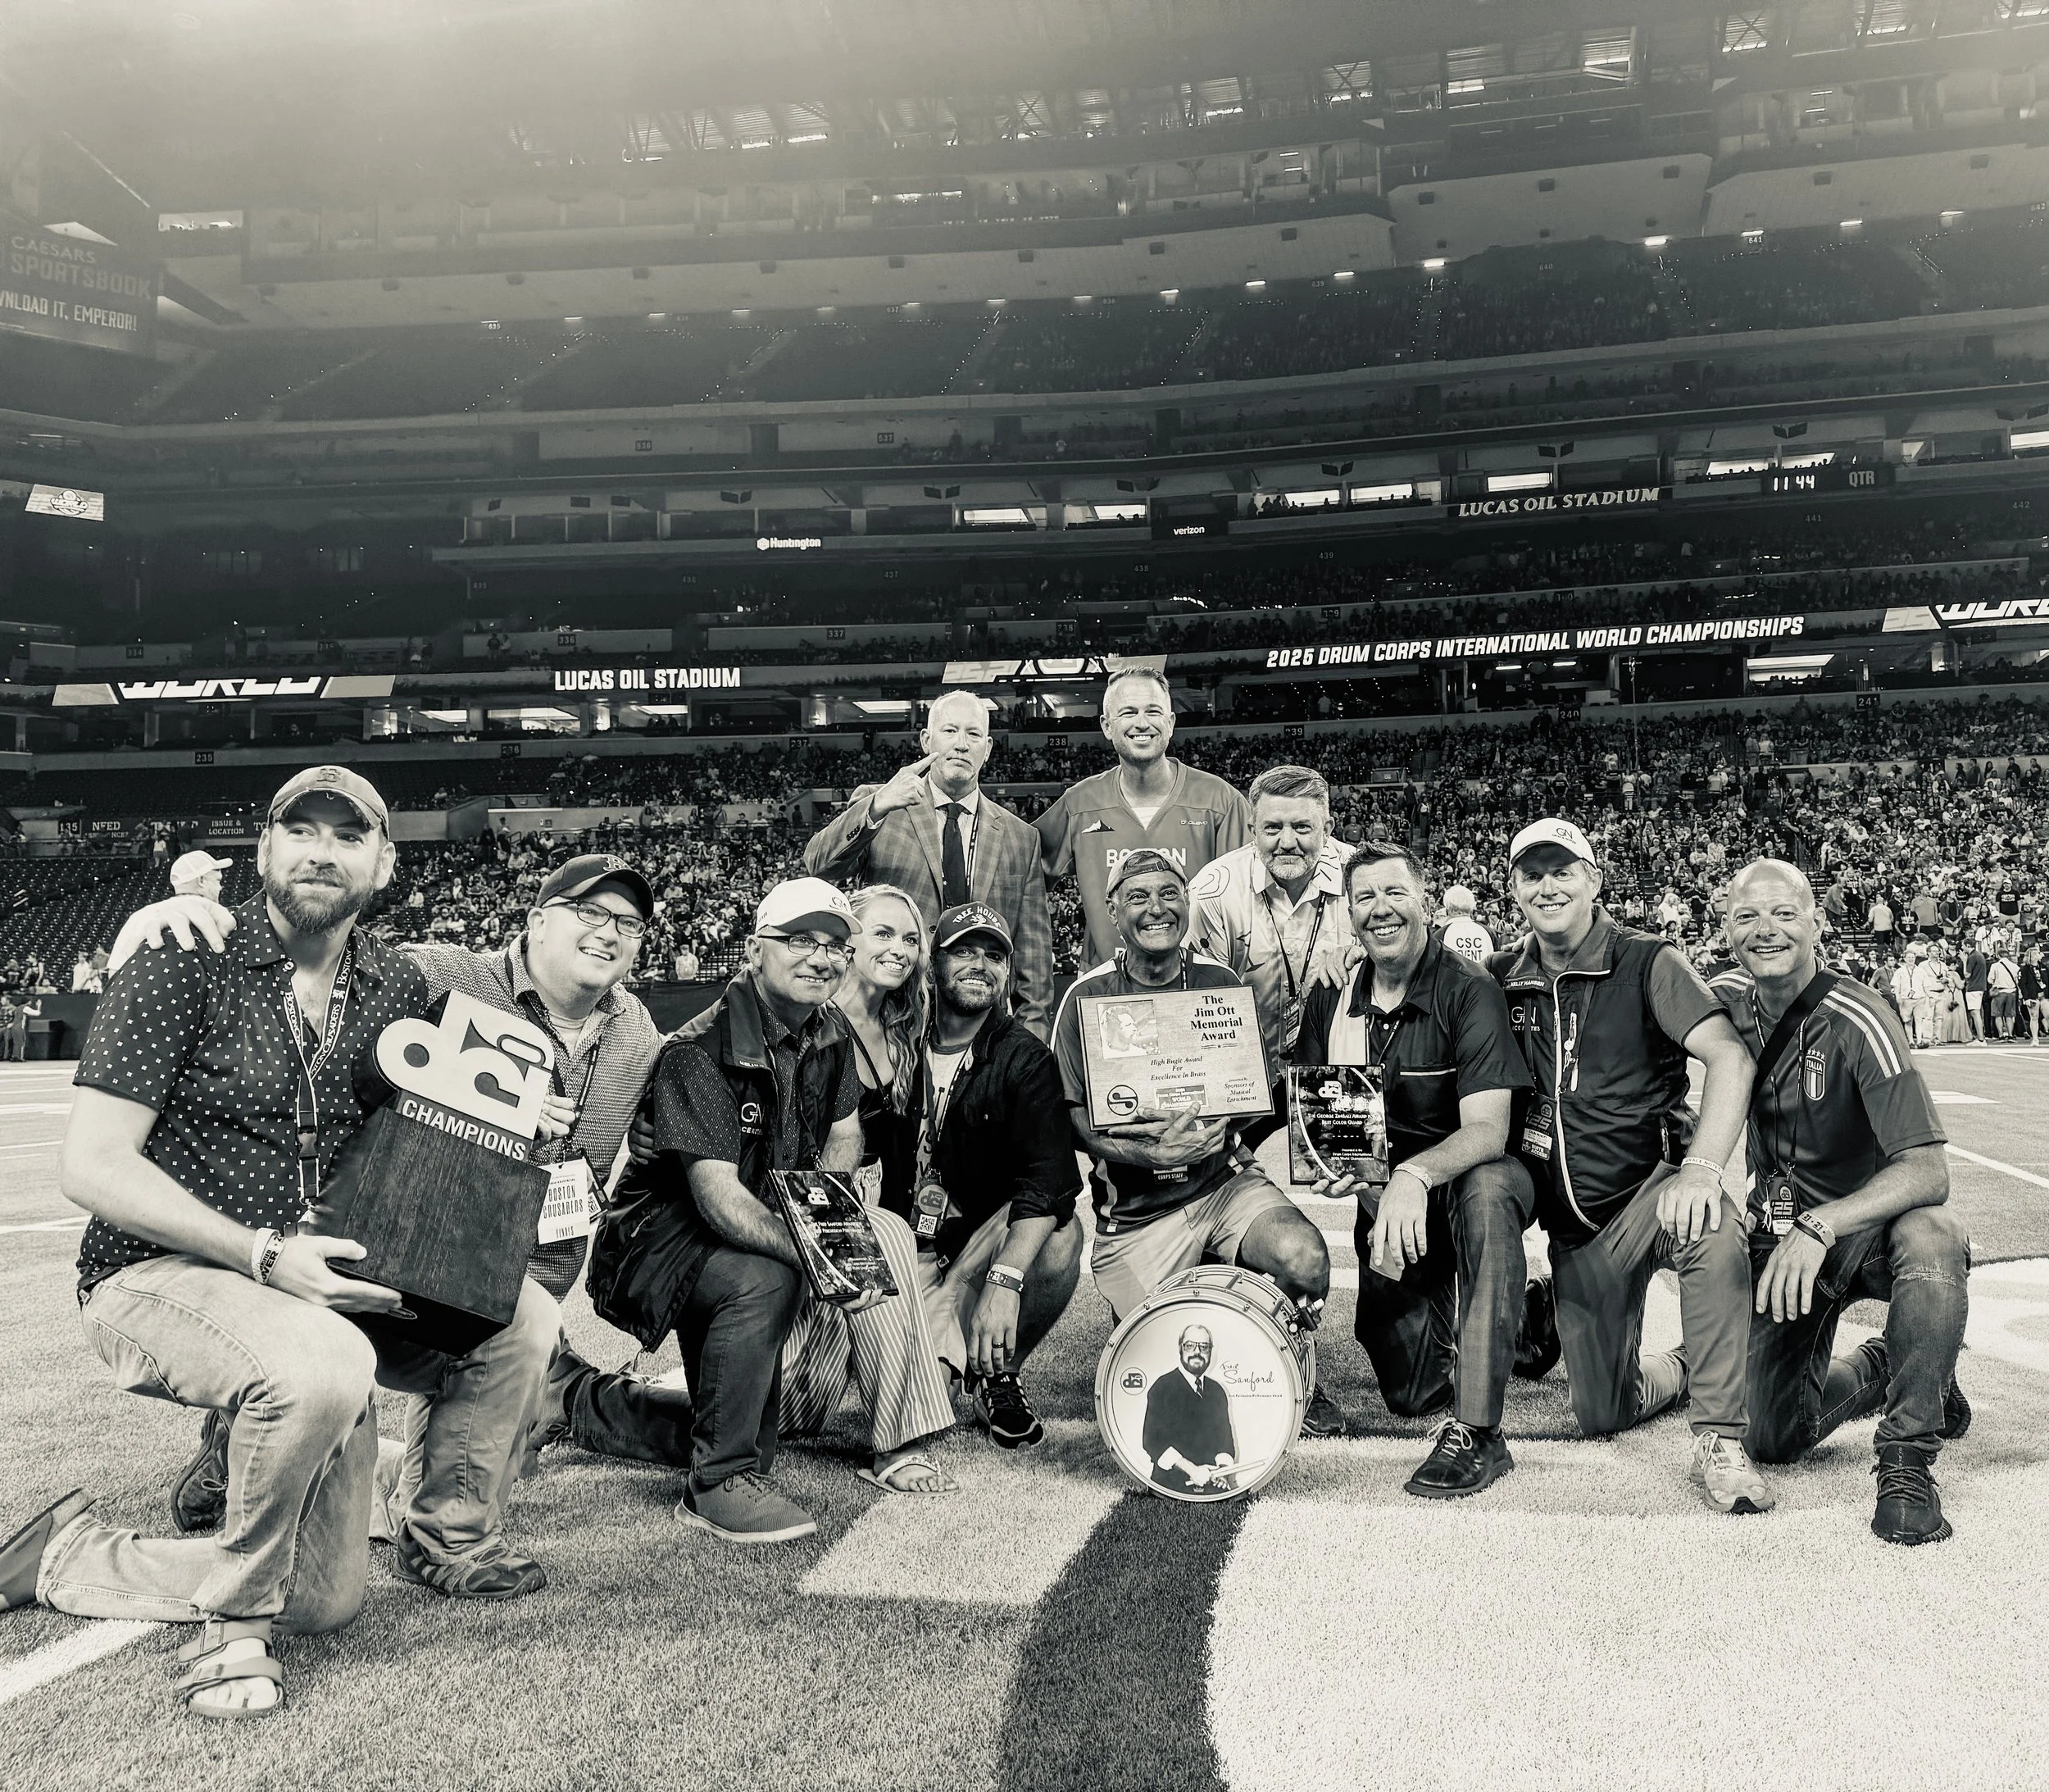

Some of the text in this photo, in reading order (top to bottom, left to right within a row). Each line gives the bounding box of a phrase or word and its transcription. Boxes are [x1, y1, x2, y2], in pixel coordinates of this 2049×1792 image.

[11, 236, 96, 264] CAESARS
[11, 252, 153, 300] SPORTSBOOK
[74, 304, 138, 332] EMPEROR!
[1796, 475, 1815, 489] 44
[1849, 470, 1875, 488] QTR
[1458, 487, 1661, 519] LUCAS OIL STADIUM
[1174, 526, 1205, 535] verizon
[770, 537, 821, 550] Huntington
[829, 630, 844, 639] 337
[1266, 616, 1805, 668] 2025 DRUM CORPS INTERNATIONAL WORLD CHAMPIONSHIPS
[554, 667, 741, 691] LUCAS OIL STADIUM
[1049, 738, 1067, 746] 238
[196, 754, 213, 762] 235
[952, 907, 974, 925] TREE
[1456, 937, 1483, 948] CSC
[1458, 950, 1483, 962] VENT
[1202, 995, 1224, 1005] The
[1194, 1006, 1235, 1017] Jim Ott
[1190, 1017, 1243, 1030] Memorial
[1201, 1030, 1236, 1041] Award
[1806, 1059, 1823, 1072] ITALIA
[1227, 1095, 1256, 1103] Enrichment
[402, 1099, 527, 1162] CHAMPIONS
[547, 1185, 575, 1203] BOSTON
[543, 1198, 584, 1219] CRUSADERS
[556, 1226, 575, 1239] FINALS
[1223, 1369, 1275, 1392] Sanford
